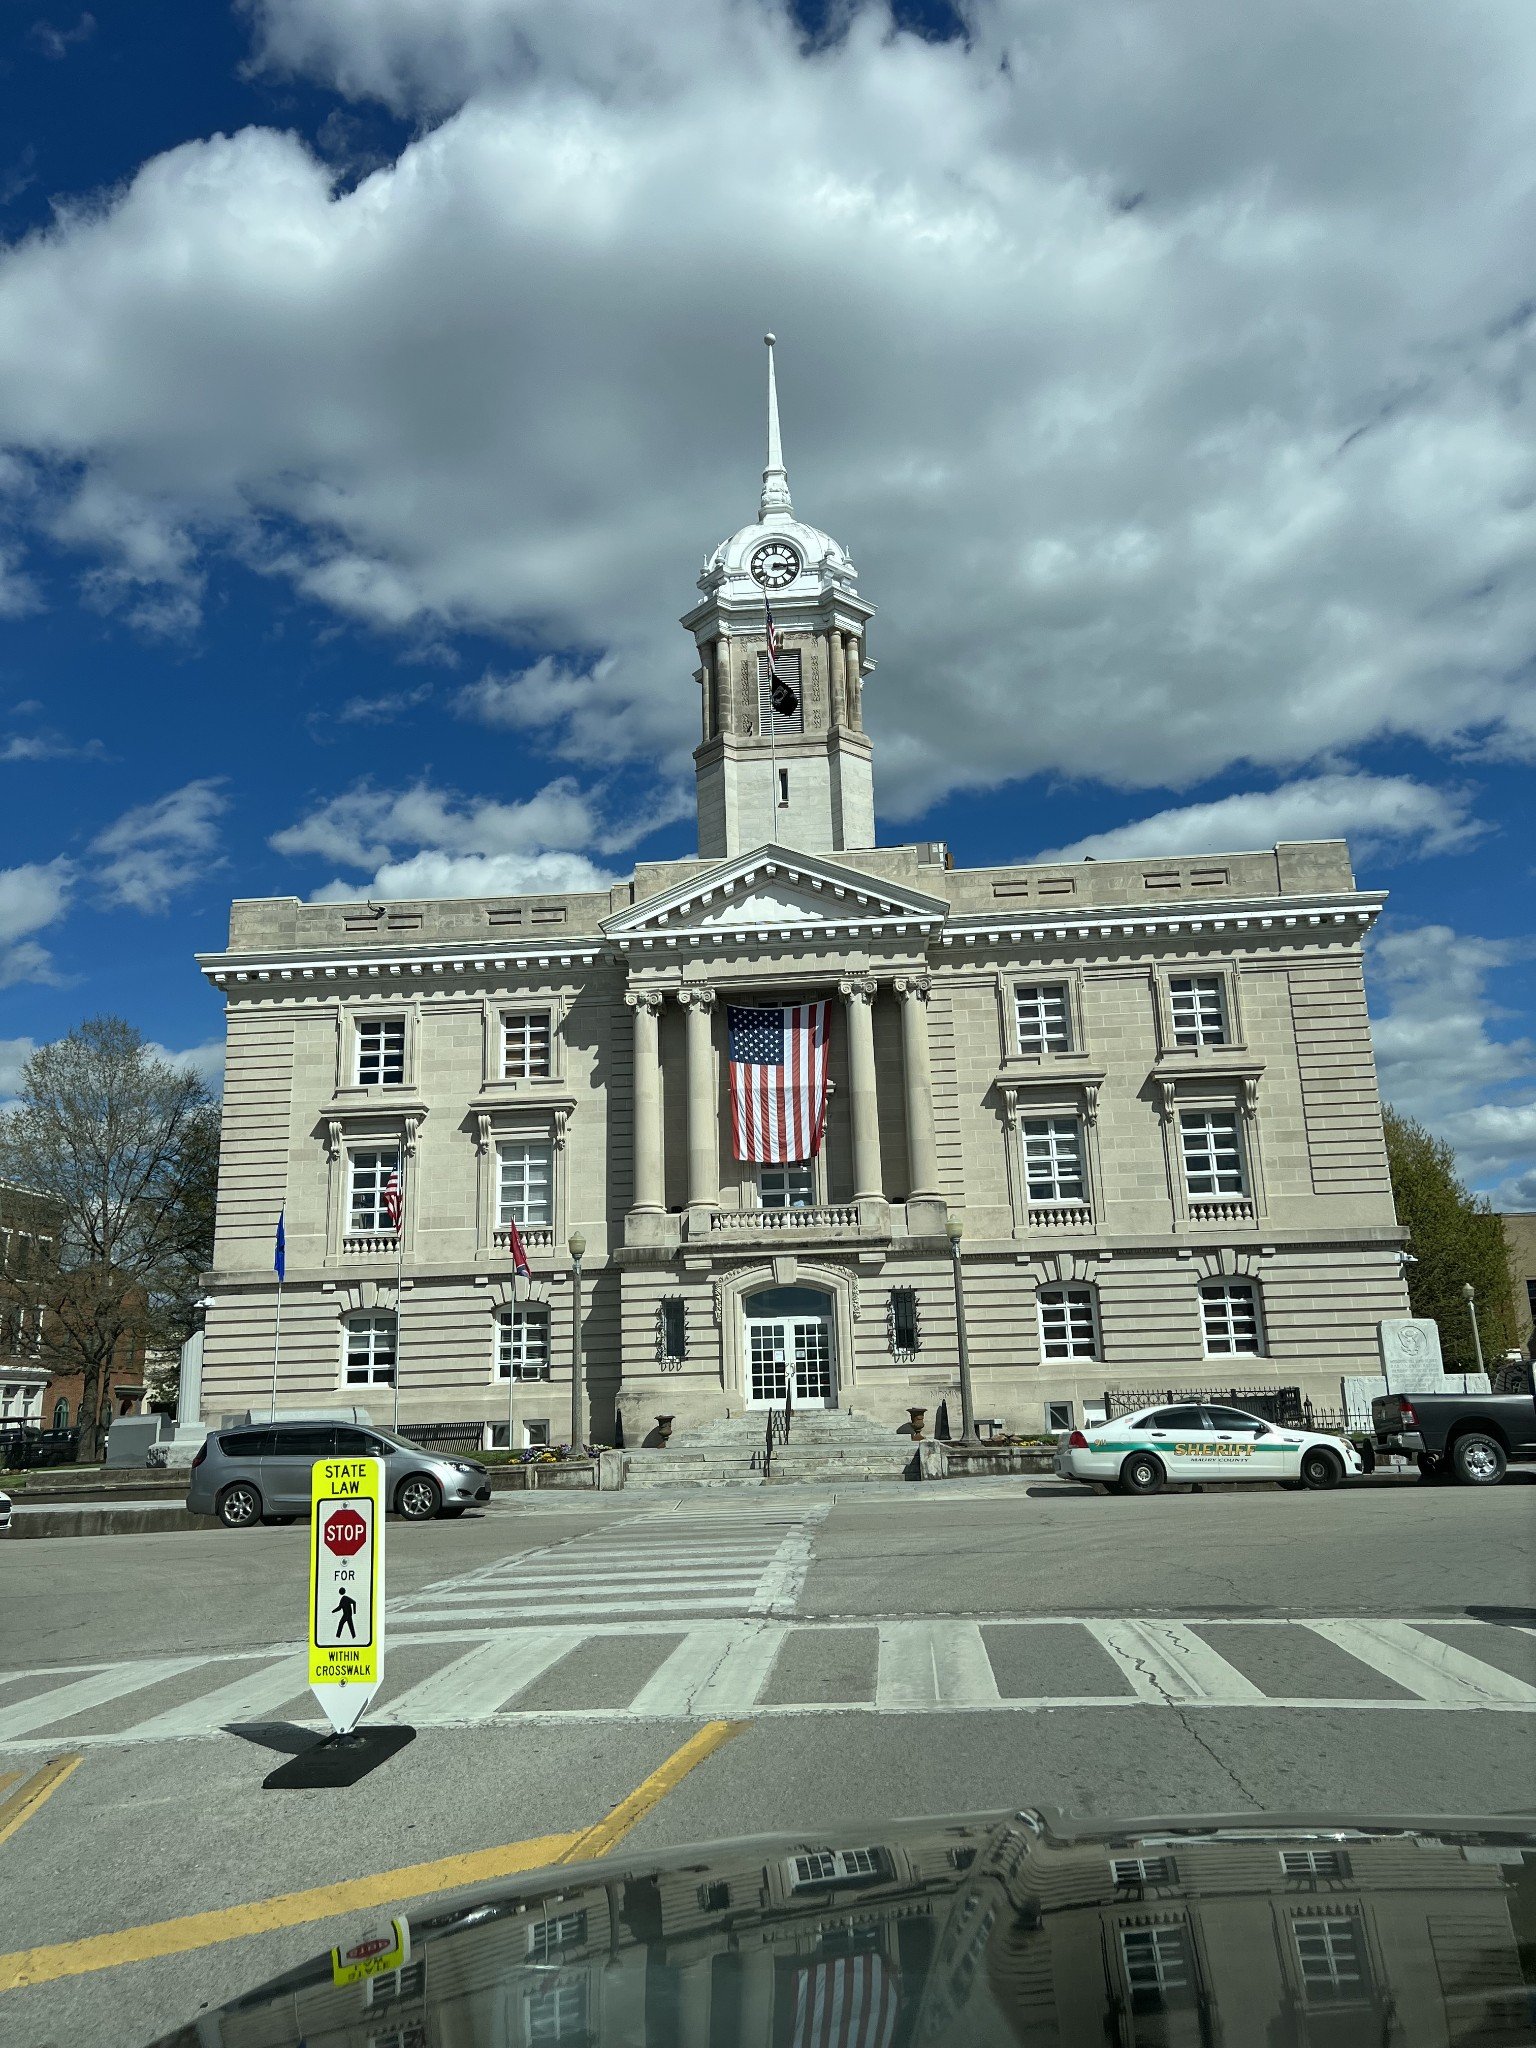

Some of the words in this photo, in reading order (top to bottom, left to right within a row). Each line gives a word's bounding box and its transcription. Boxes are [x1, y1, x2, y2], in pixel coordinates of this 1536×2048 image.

[1173, 1442, 1257, 1457] SHERIFF
[325, 1463, 367, 1479] STATE
[331, 1481, 360, 1495] LAW
[326, 1523, 364, 1542] STOP
[334, 1570, 355, 1581] FOR
[328, 1650, 360, 1662] WITHIN
[315, 1664, 371, 1677] CROSSWALK
